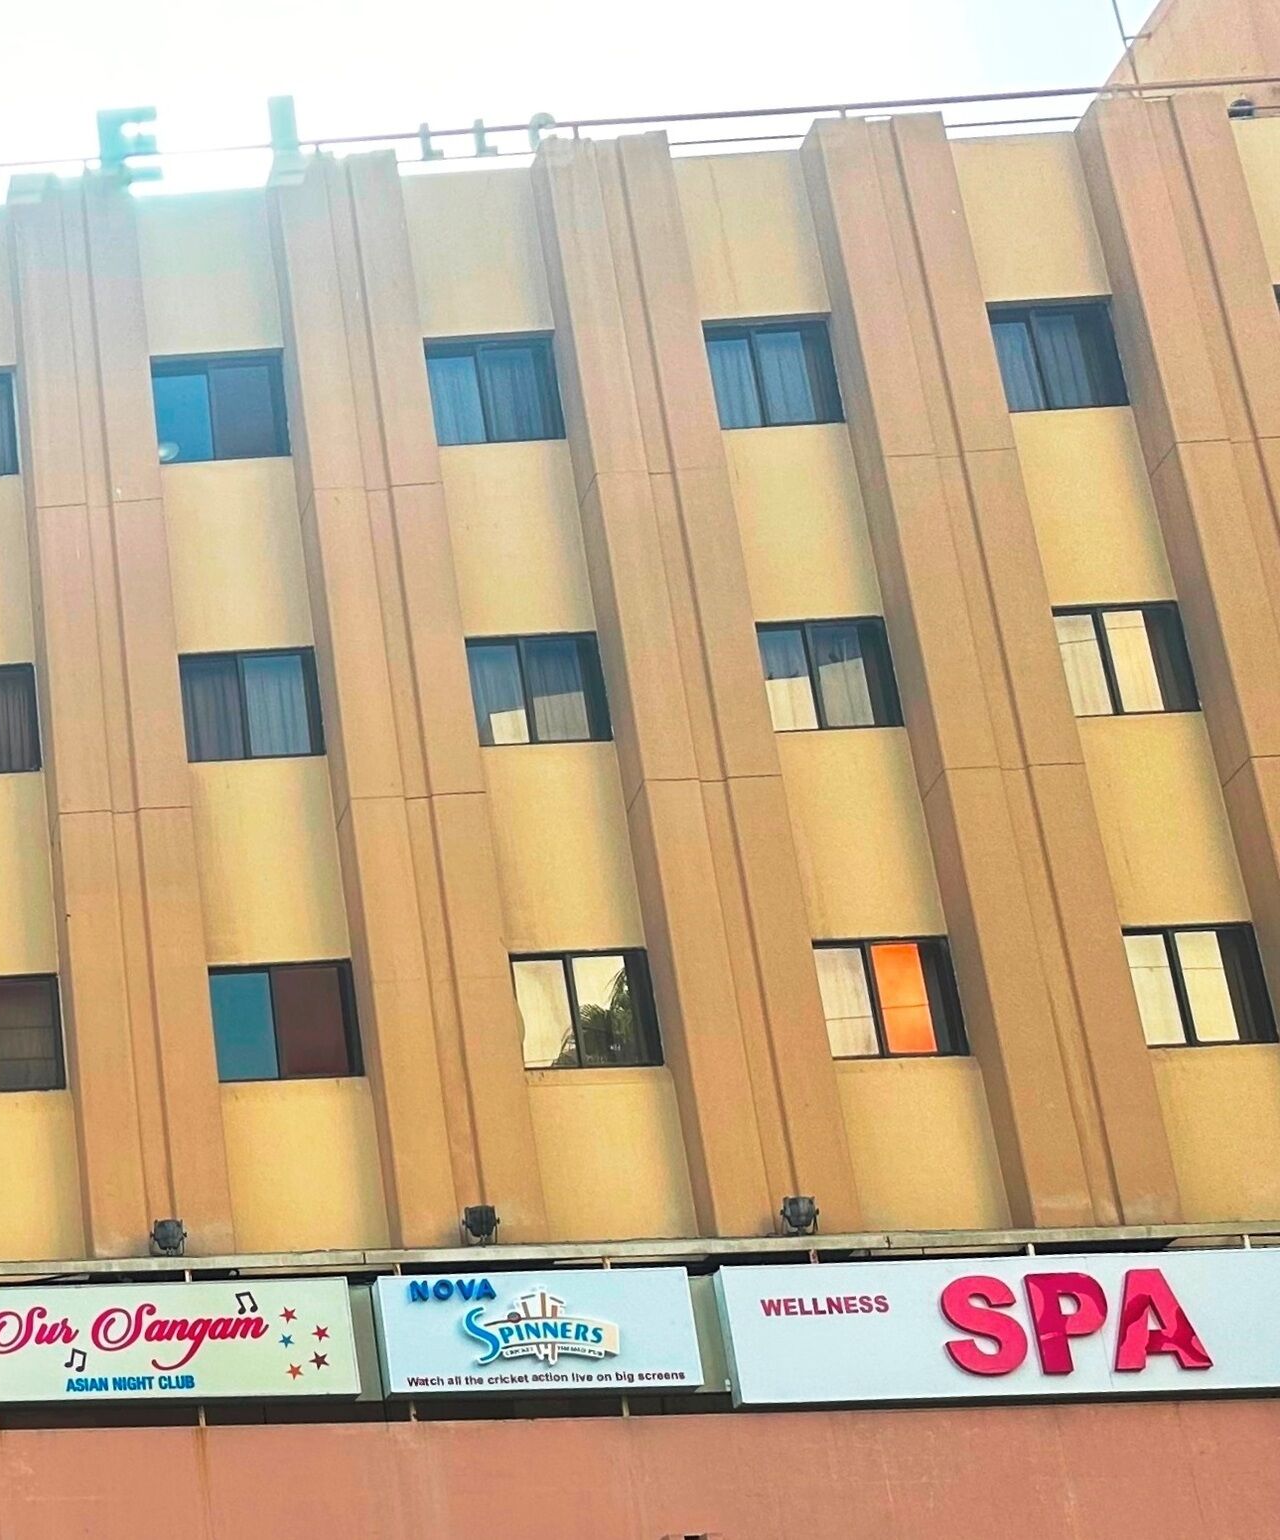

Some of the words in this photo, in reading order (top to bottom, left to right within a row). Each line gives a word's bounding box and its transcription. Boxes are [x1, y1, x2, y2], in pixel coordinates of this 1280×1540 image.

[409, 1279, 497, 1302] NOVA
[760, 1294, 890, 1317] WELLNESS
[940, 1268, 1214, 1377] SPA
[91, 1303, 269, 1371] Sangam
[465, 1307, 603, 1363] SPINNERS
[66, 1376, 109, 1392] ASIAN
[112, 1376, 154, 1391] NIGHT
[158, 1375, 195, 1390] CLUB
[407, 1376, 445, 1387] Watch
[448, 1376, 463, 1386] all
[465, 1375, 484, 1386] the
[487, 1374, 529, 1385] cricket
[531, 1372, 568, 1383] action
[571, 1372, 593, 1383] live
[596, 1373, 613, 1382] on
[616, 1371, 634, 1384] big
[638, 1371, 686, 1382] screens
